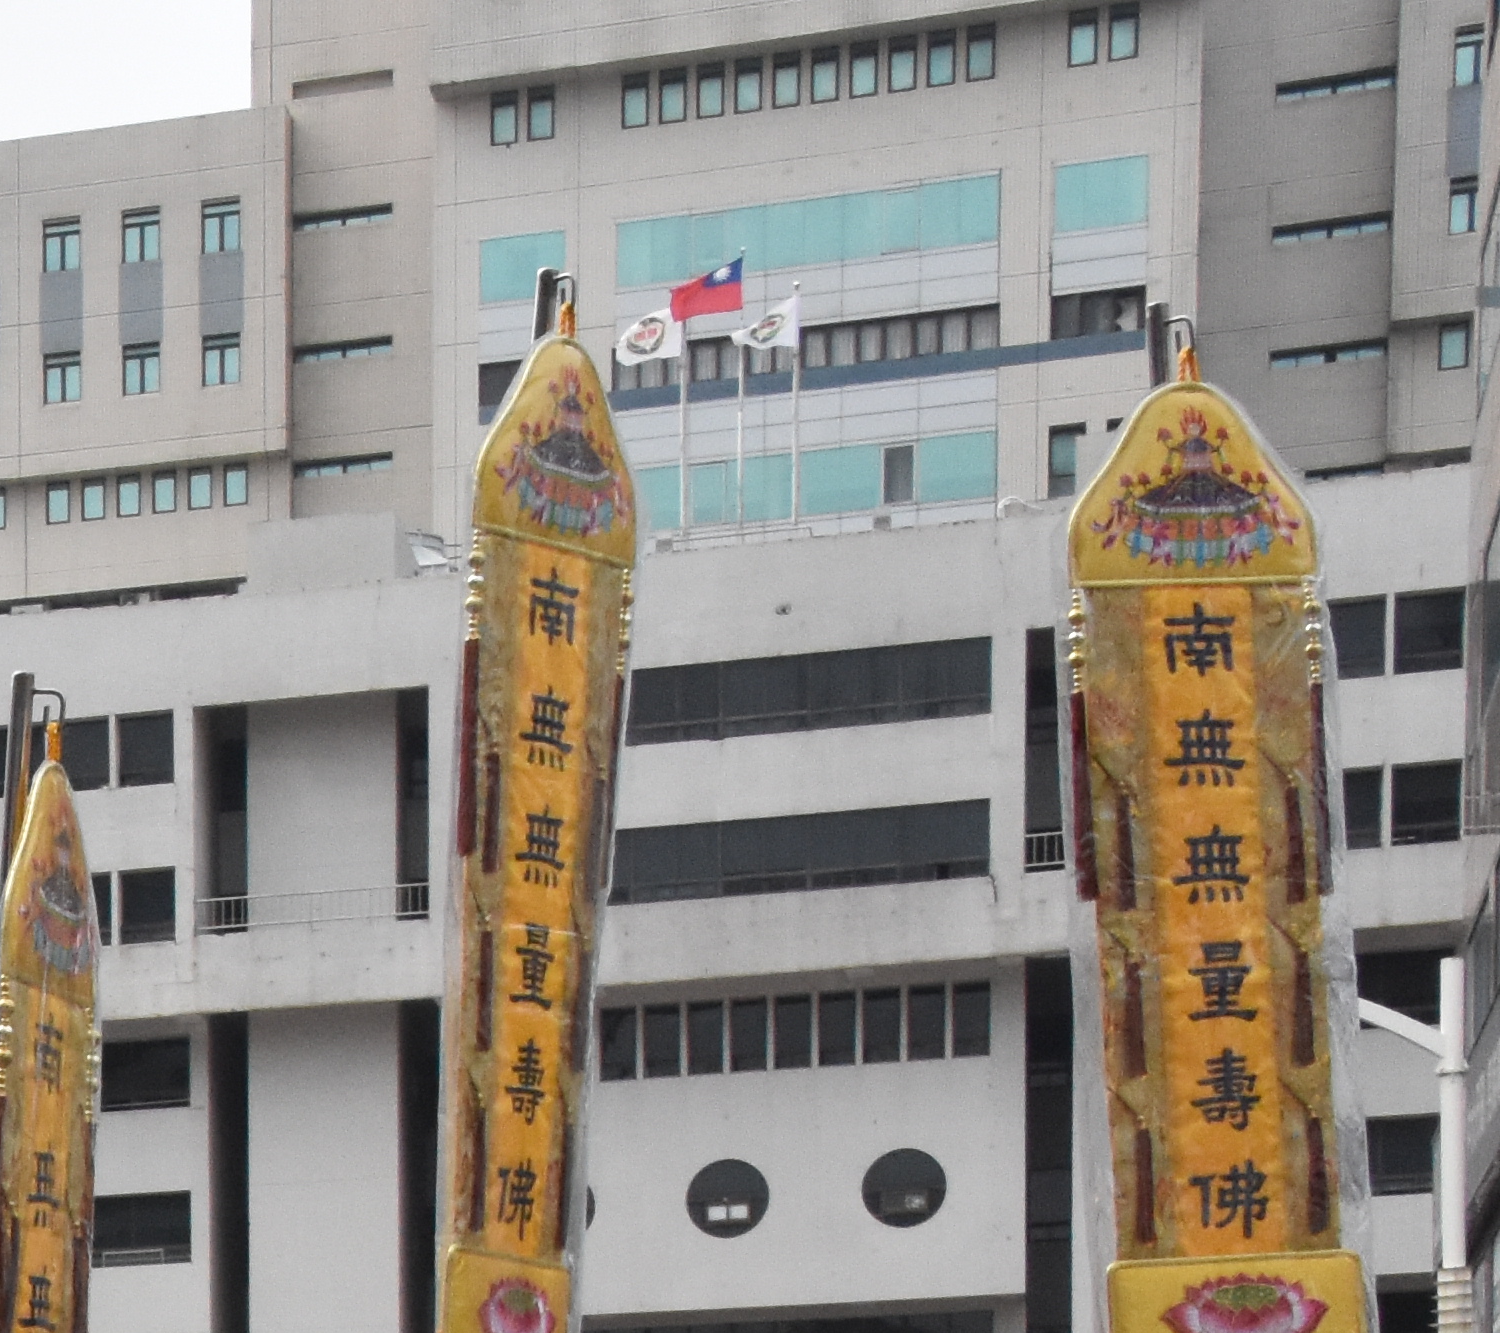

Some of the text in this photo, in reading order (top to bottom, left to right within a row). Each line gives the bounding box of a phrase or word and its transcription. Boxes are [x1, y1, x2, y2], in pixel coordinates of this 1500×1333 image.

[496, 566, 577, 1242] 南無無量壽佛
[1162, 602, 1271, 1240] 南無無量壽佛
